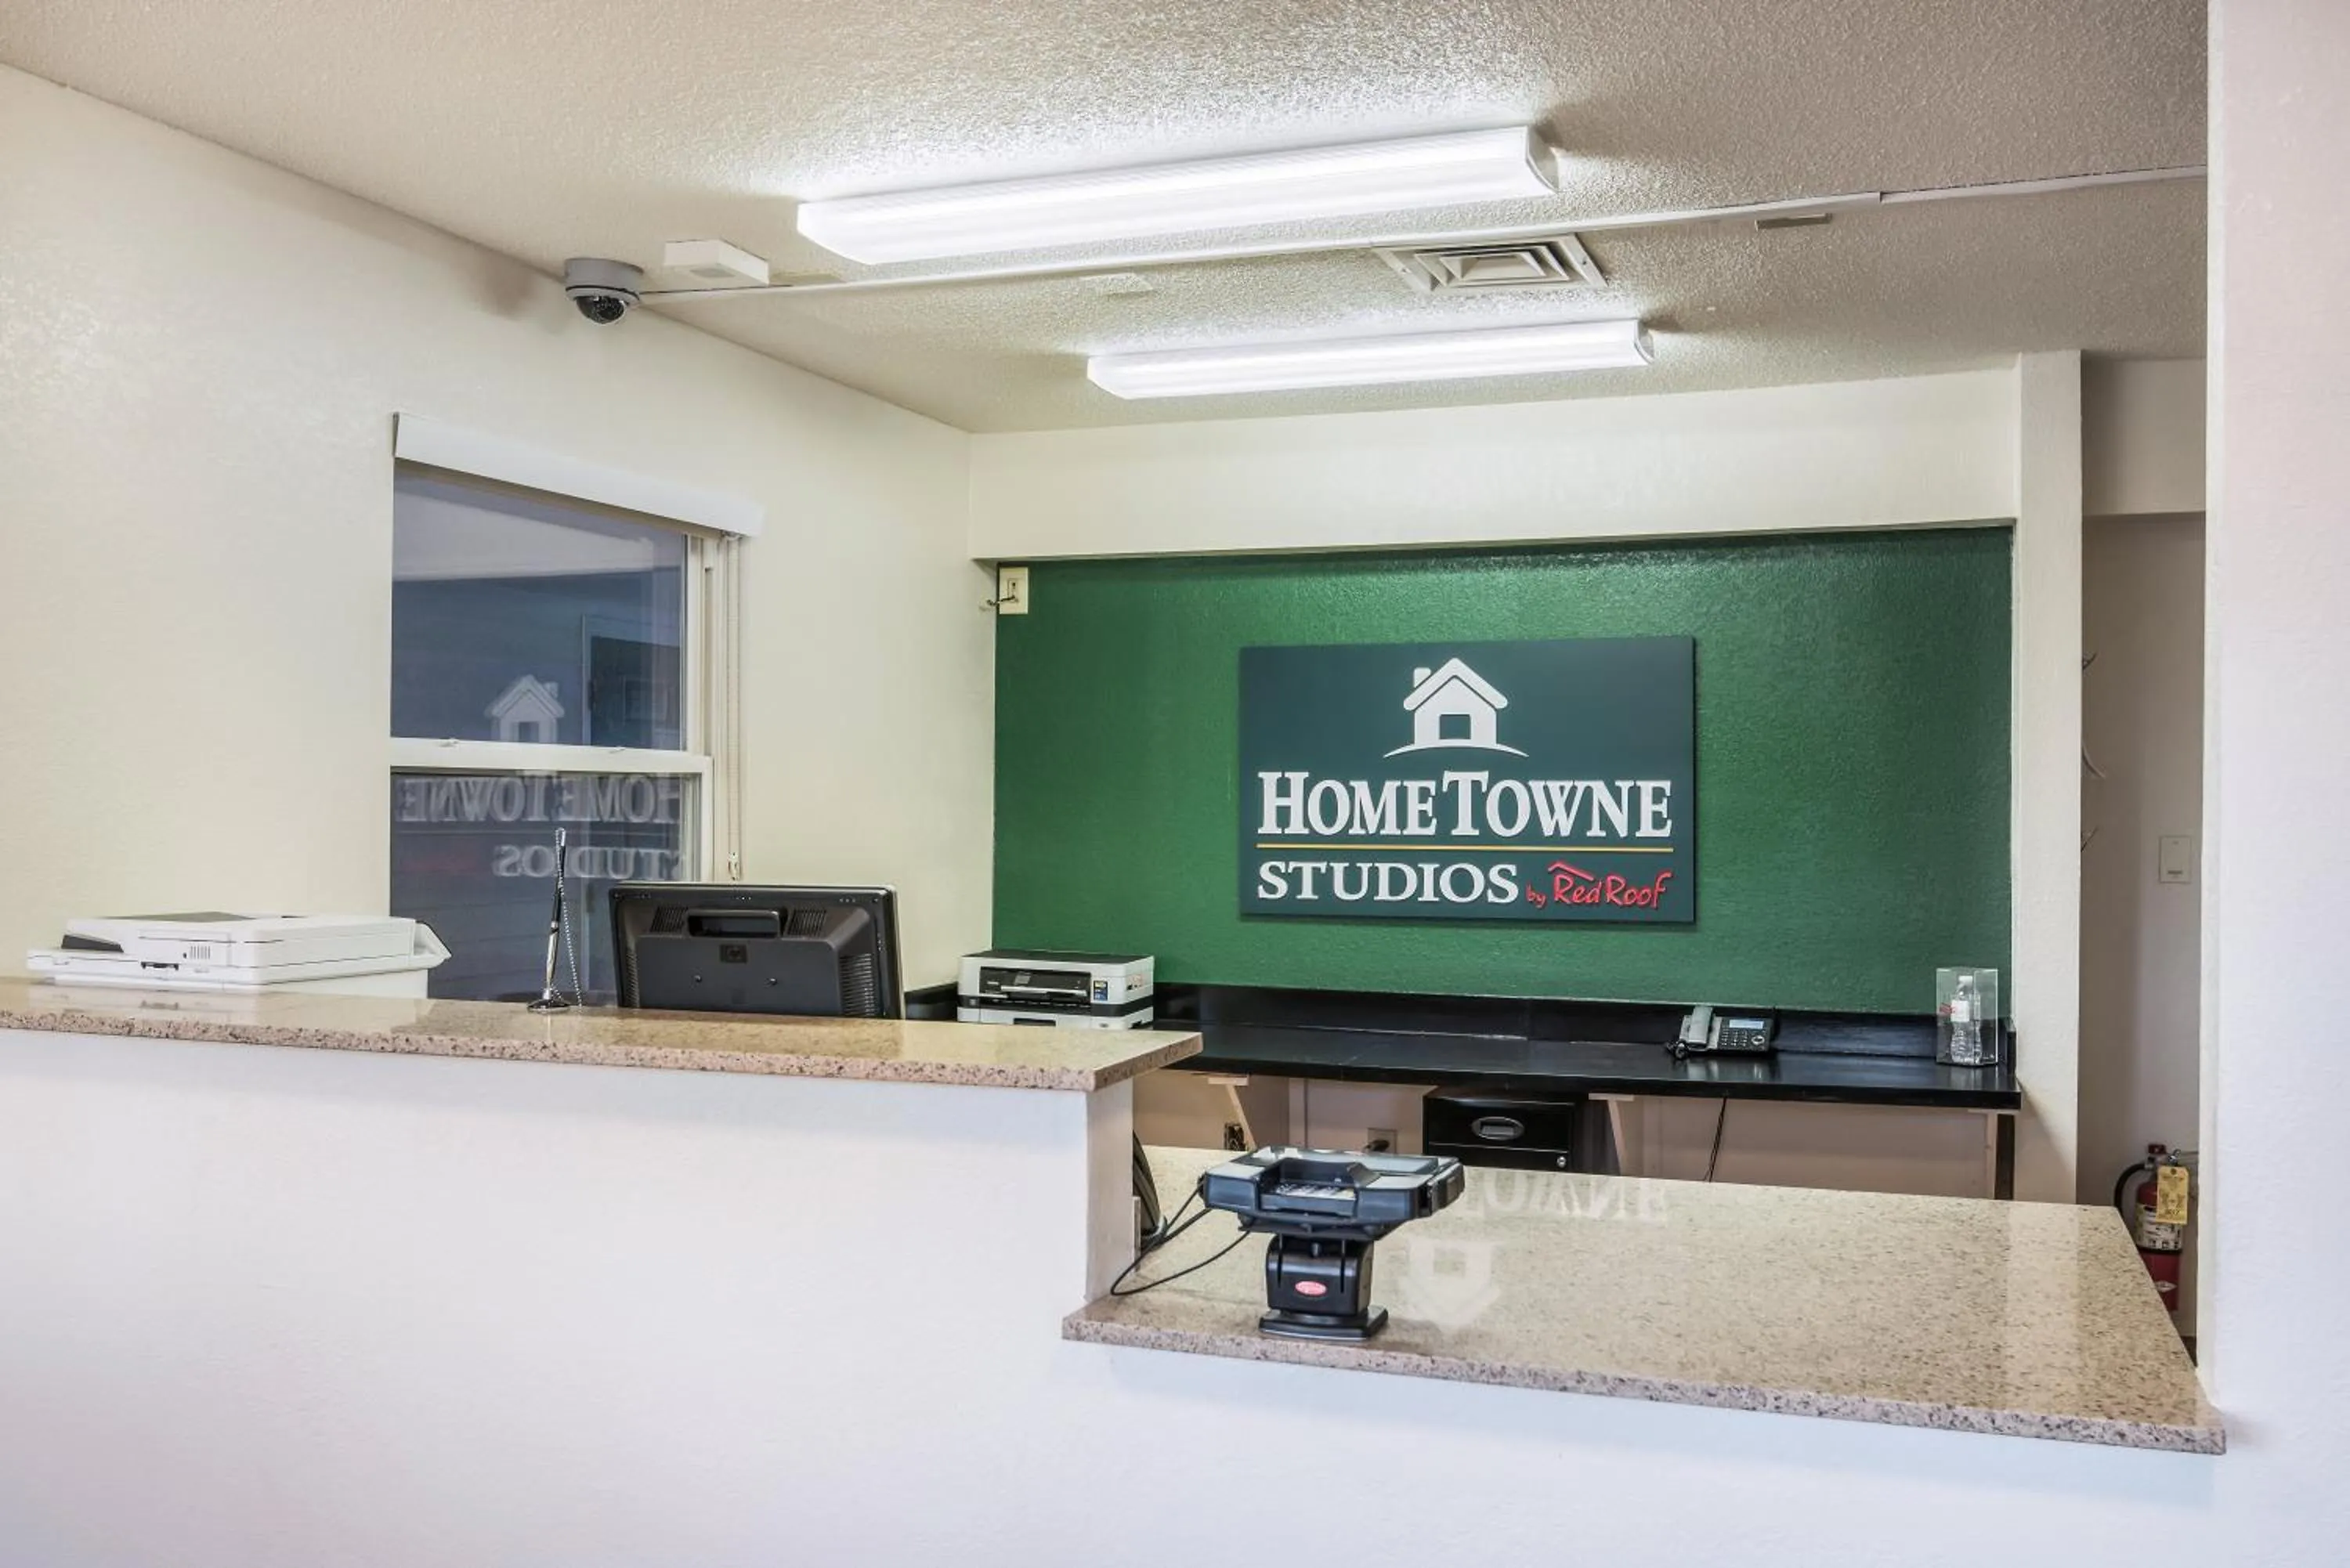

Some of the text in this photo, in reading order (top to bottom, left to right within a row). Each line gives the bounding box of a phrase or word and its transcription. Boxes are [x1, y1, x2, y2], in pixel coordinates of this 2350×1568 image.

[1256, 770, 1673, 838] HOMETOWNE
[1256, 861, 1520, 904] STUDIOS
[1526, 884, 1547, 909] by
